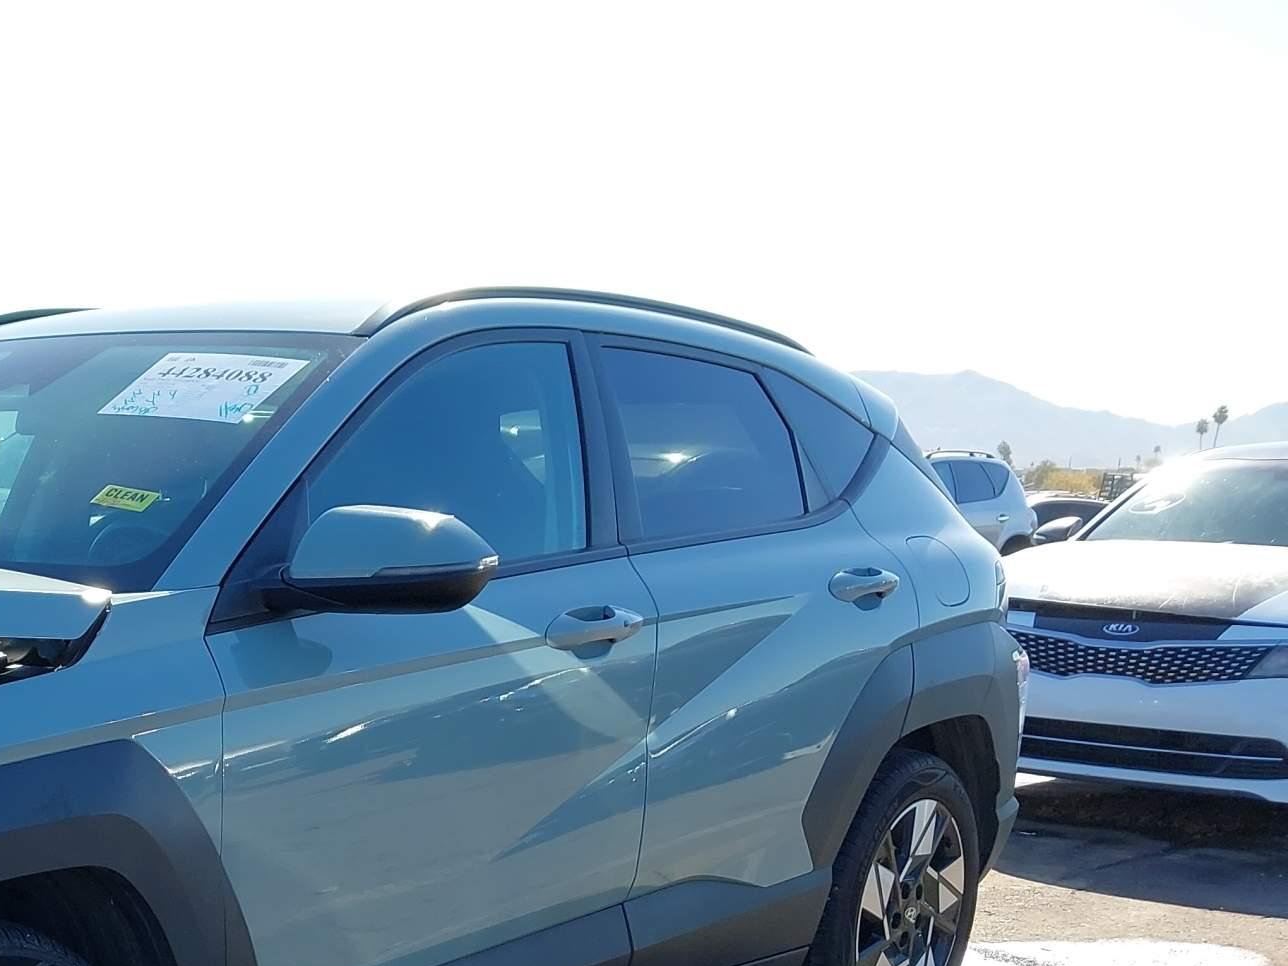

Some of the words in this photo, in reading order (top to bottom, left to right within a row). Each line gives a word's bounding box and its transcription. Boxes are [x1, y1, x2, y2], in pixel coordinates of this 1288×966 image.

[159, 366, 273, 384] 44284088
[105, 488, 149, 503] CLEAN
[1108, 623, 1133, 633] KIA
